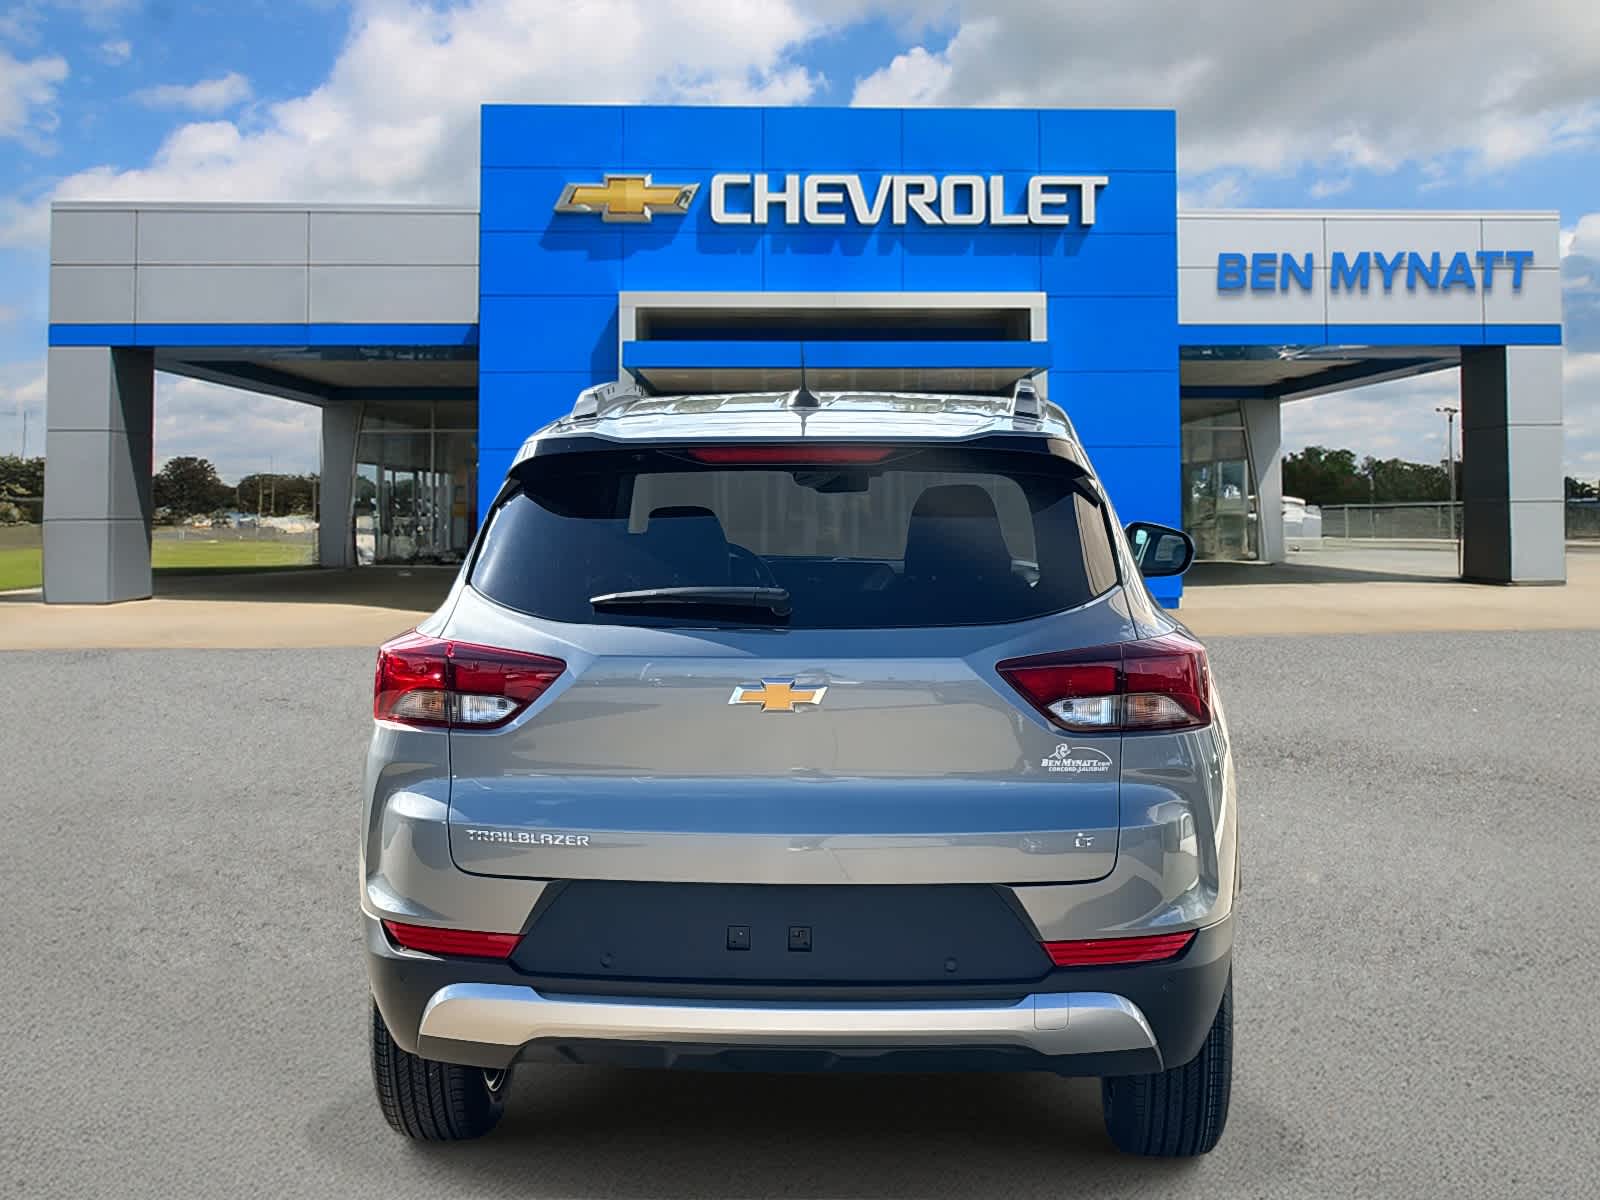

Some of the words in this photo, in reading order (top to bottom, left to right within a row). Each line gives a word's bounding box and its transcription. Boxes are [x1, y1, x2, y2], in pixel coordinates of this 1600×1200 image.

[710, 173, 1109, 225] CHEVROLET
[1217, 252, 1313, 290] BEN
[1330, 250, 1534, 290] MYNATT
[464, 829, 590, 847] TRAILBLAZER
